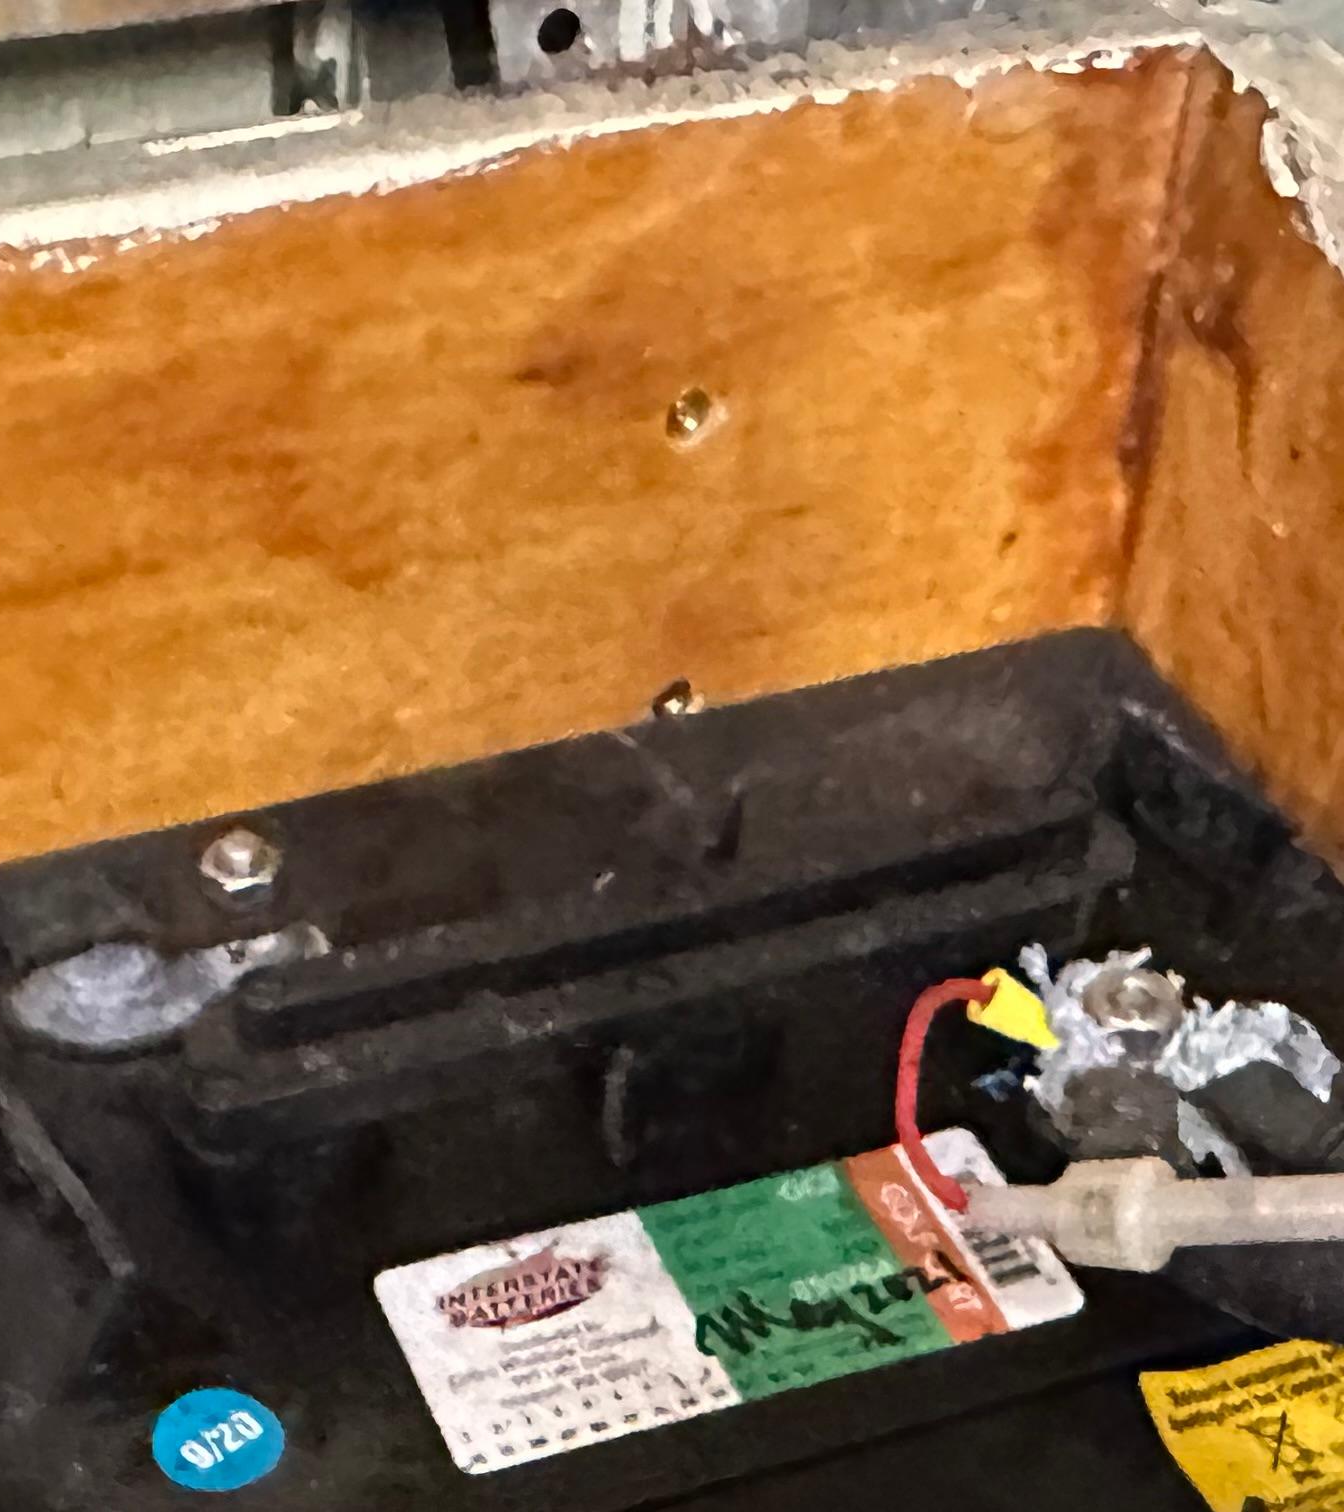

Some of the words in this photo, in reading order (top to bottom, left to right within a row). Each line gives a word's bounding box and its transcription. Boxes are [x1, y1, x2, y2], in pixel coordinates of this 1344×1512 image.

[436, 1258, 606, 1311] INTERSTATE
[449, 1278, 602, 1327] BATTERIES
[696, 1287, 908, 1356] May
[851, 1250, 972, 1314] 2021
